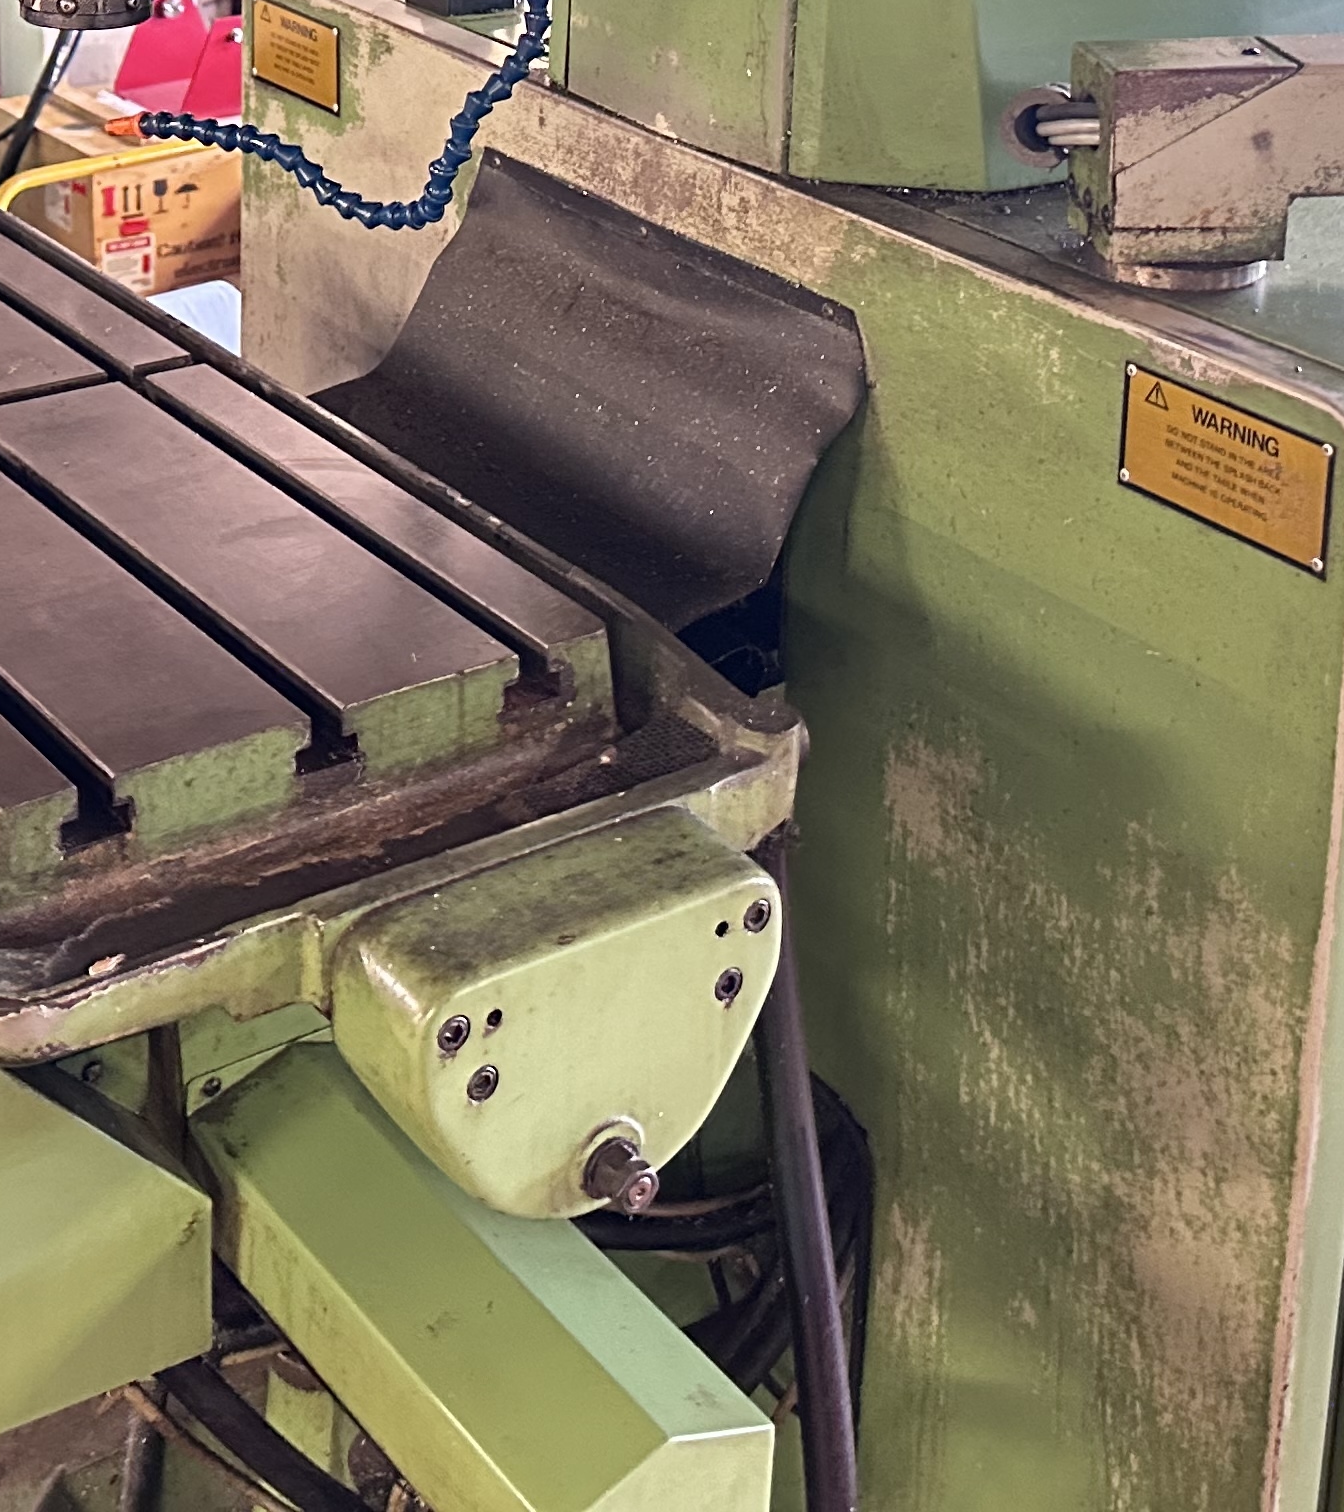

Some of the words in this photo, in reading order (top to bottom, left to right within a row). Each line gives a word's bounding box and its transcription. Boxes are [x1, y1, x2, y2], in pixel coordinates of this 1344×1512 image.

[280, 16, 318, 42] WARNING
[1166, 424, 1179, 436] DO
[1181, 431, 1198, 445] NOT
[1200, 439, 1226, 456] STAND
[1228, 452, 1237, 461] IN
[1239, 455, 1254, 469] THE
[1192, 404, 1279, 458] WARNING
[1165, 438, 1204, 462] BETWEEN
[1206, 456, 1220, 469] THE
[1176, 458, 1193, 471] AND
[1195, 465, 1210, 477] THE
